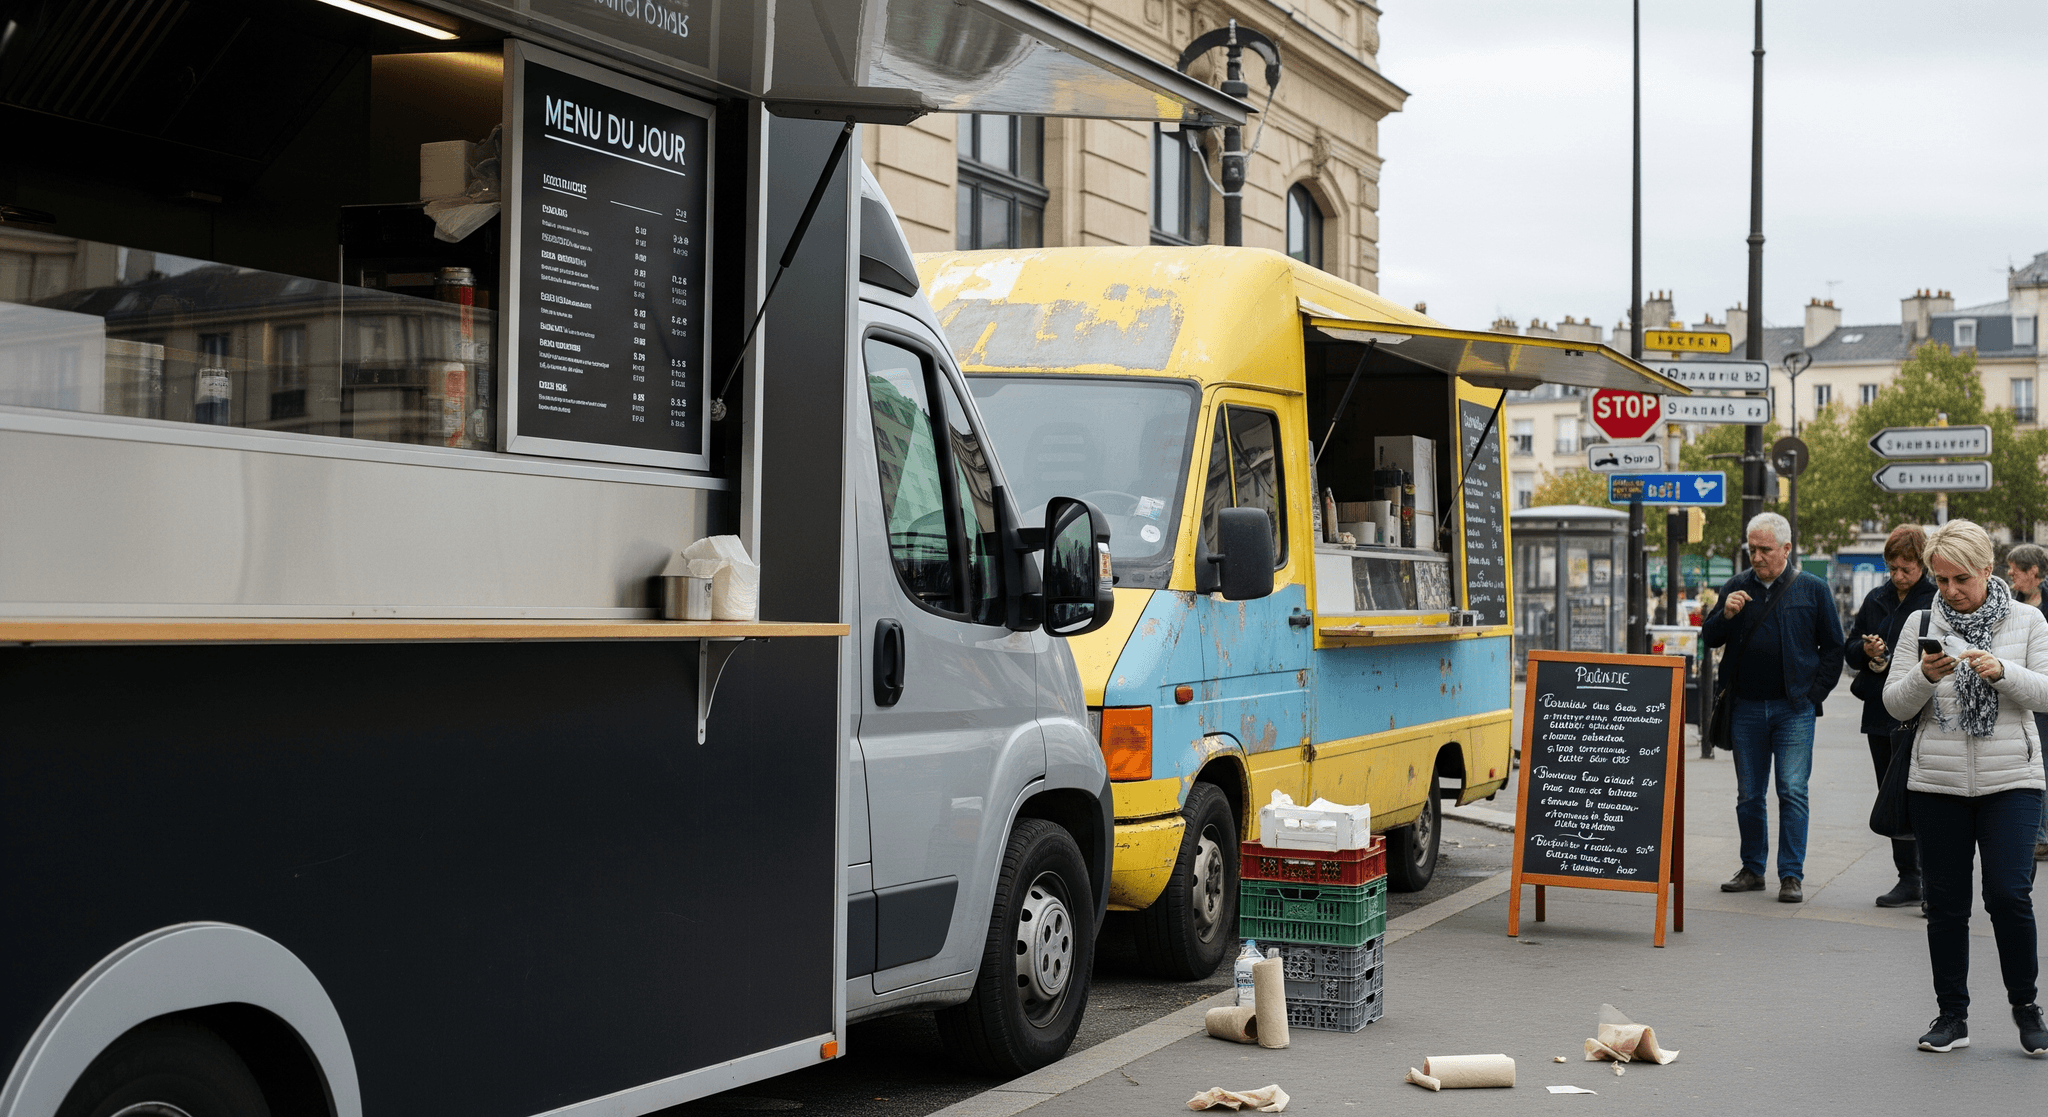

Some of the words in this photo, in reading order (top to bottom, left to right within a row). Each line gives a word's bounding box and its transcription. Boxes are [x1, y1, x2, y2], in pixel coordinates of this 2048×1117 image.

[545, 95, 601, 140] MENU
[608, 114, 633, 149] DU
[638, 123, 686, 166] JOUR
[1597, 395, 1657, 419] STOP
